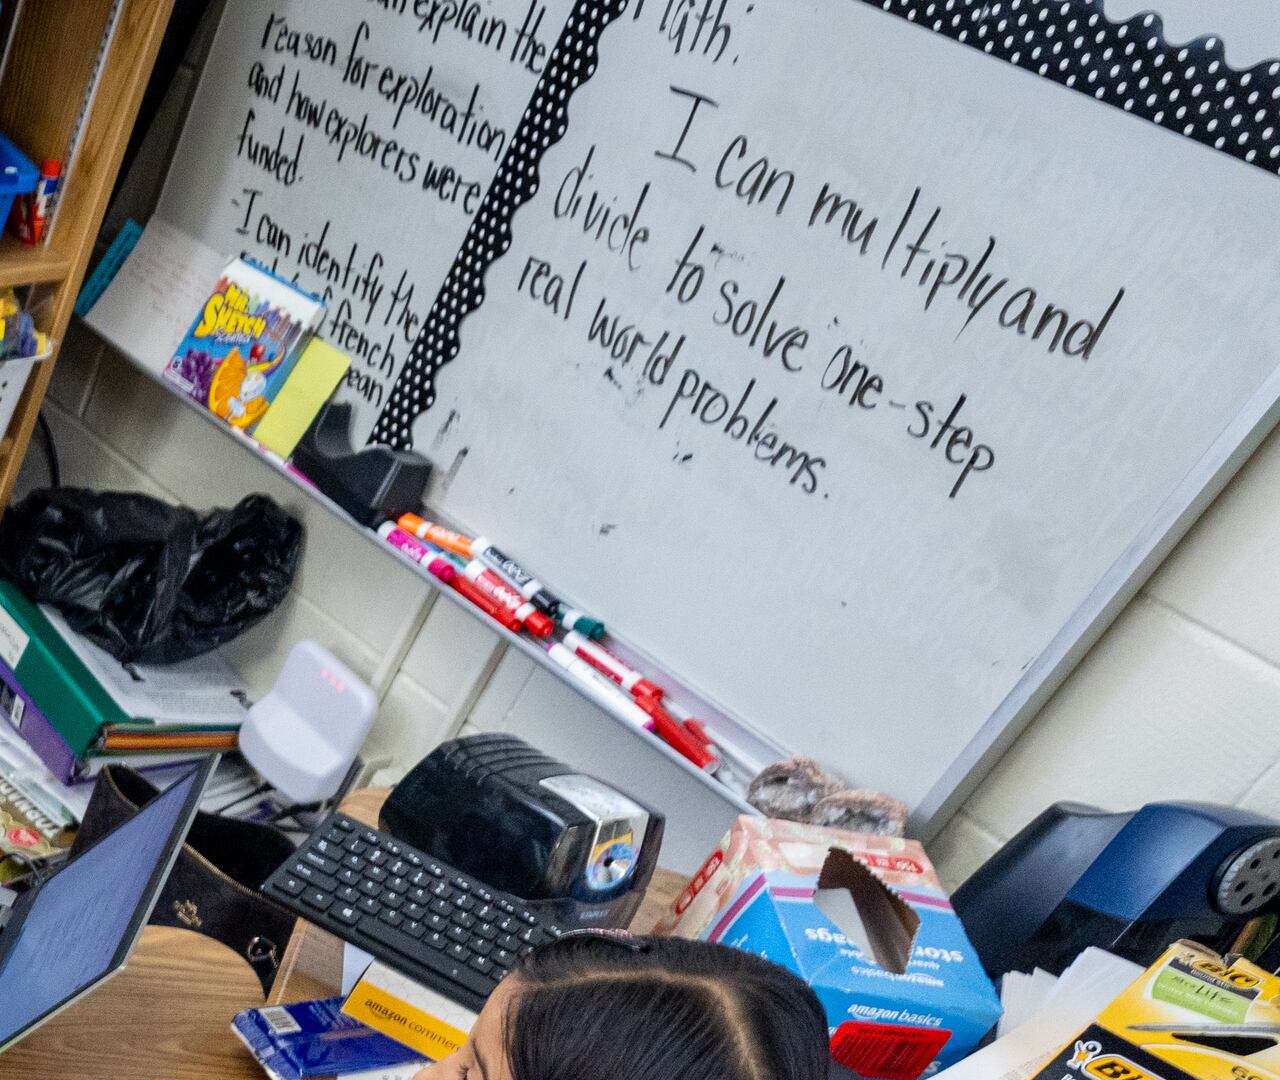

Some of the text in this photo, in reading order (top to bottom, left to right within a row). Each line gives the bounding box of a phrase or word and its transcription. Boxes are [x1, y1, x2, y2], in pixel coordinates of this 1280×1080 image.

[260, 14, 507, 162] reason for exploration
[511, 16, 549, 75] the
[237, 112, 303, 183] funded.
[248, 61, 482, 216] and how explorers were
[257, 213, 292, 251] can
[298, 223, 385, 323] identify
[387, 270, 420, 345] the
[655, 84, 1126, 362] I can multiply and
[517, 255, 830, 502] real world problems.
[553, 146, 996, 499] divide to solve one-step
[365, 997, 408, 1026] amazon
[1200, 963, 1259, 986] BIC
